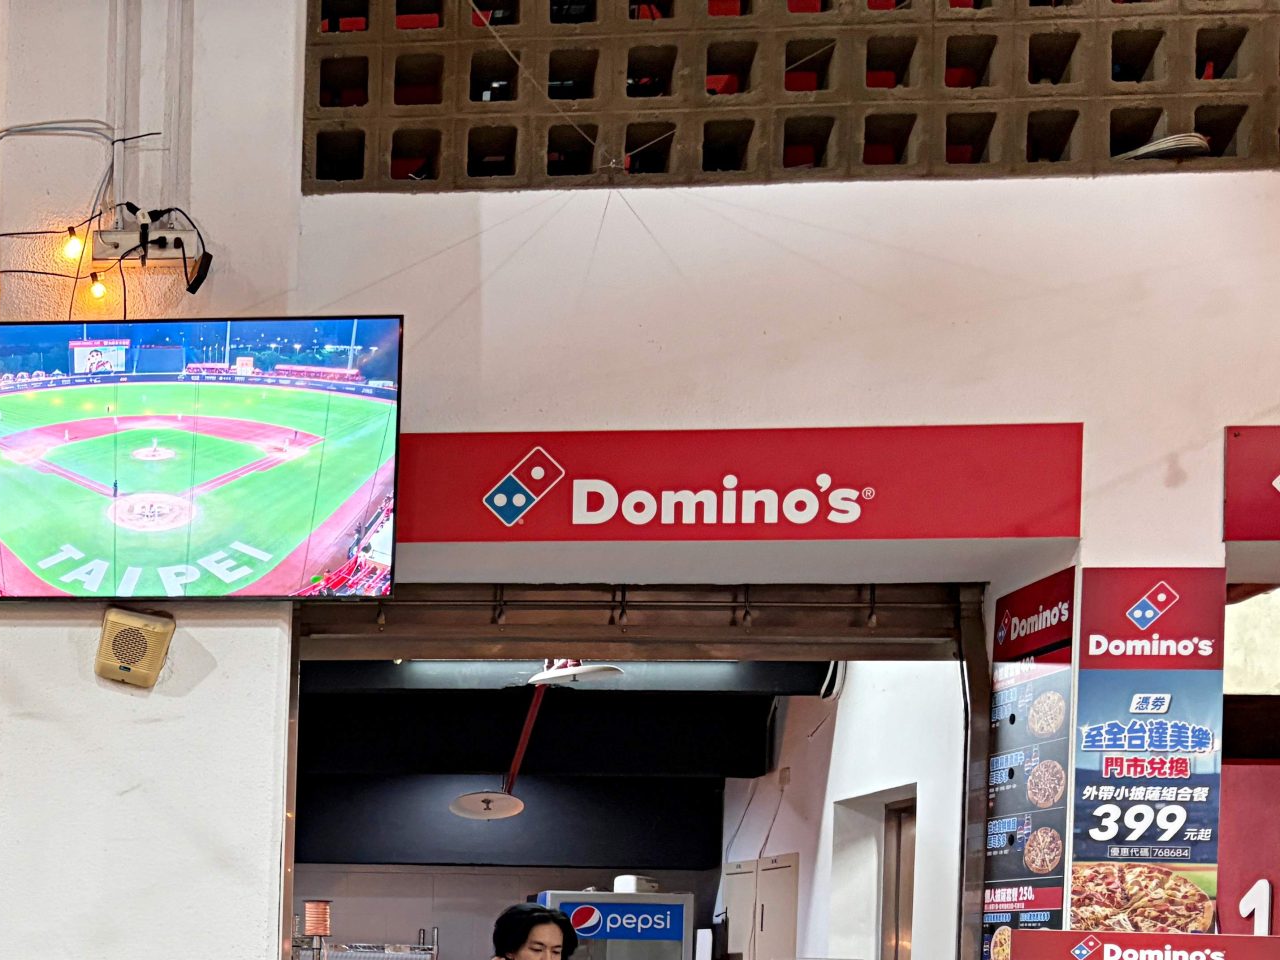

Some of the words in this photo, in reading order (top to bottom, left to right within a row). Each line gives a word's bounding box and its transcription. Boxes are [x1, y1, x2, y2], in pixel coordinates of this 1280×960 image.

[37, 540, 274, 597] TAIPEI
[1011, 601, 1069, 640] Domino's
[1088, 633, 1213, 656] Domino's
[1082, 719, 1213, 751] 至全台達美樂
[1103, 756, 1191, 778] 門市兌換
[1082, 785, 1209, 801] 外帶小披薩組合餐
[1088, 803, 1187, 841] 399
[1153, 848, 1189, 857] 768684
[606, 911, 671, 932] pepsi
